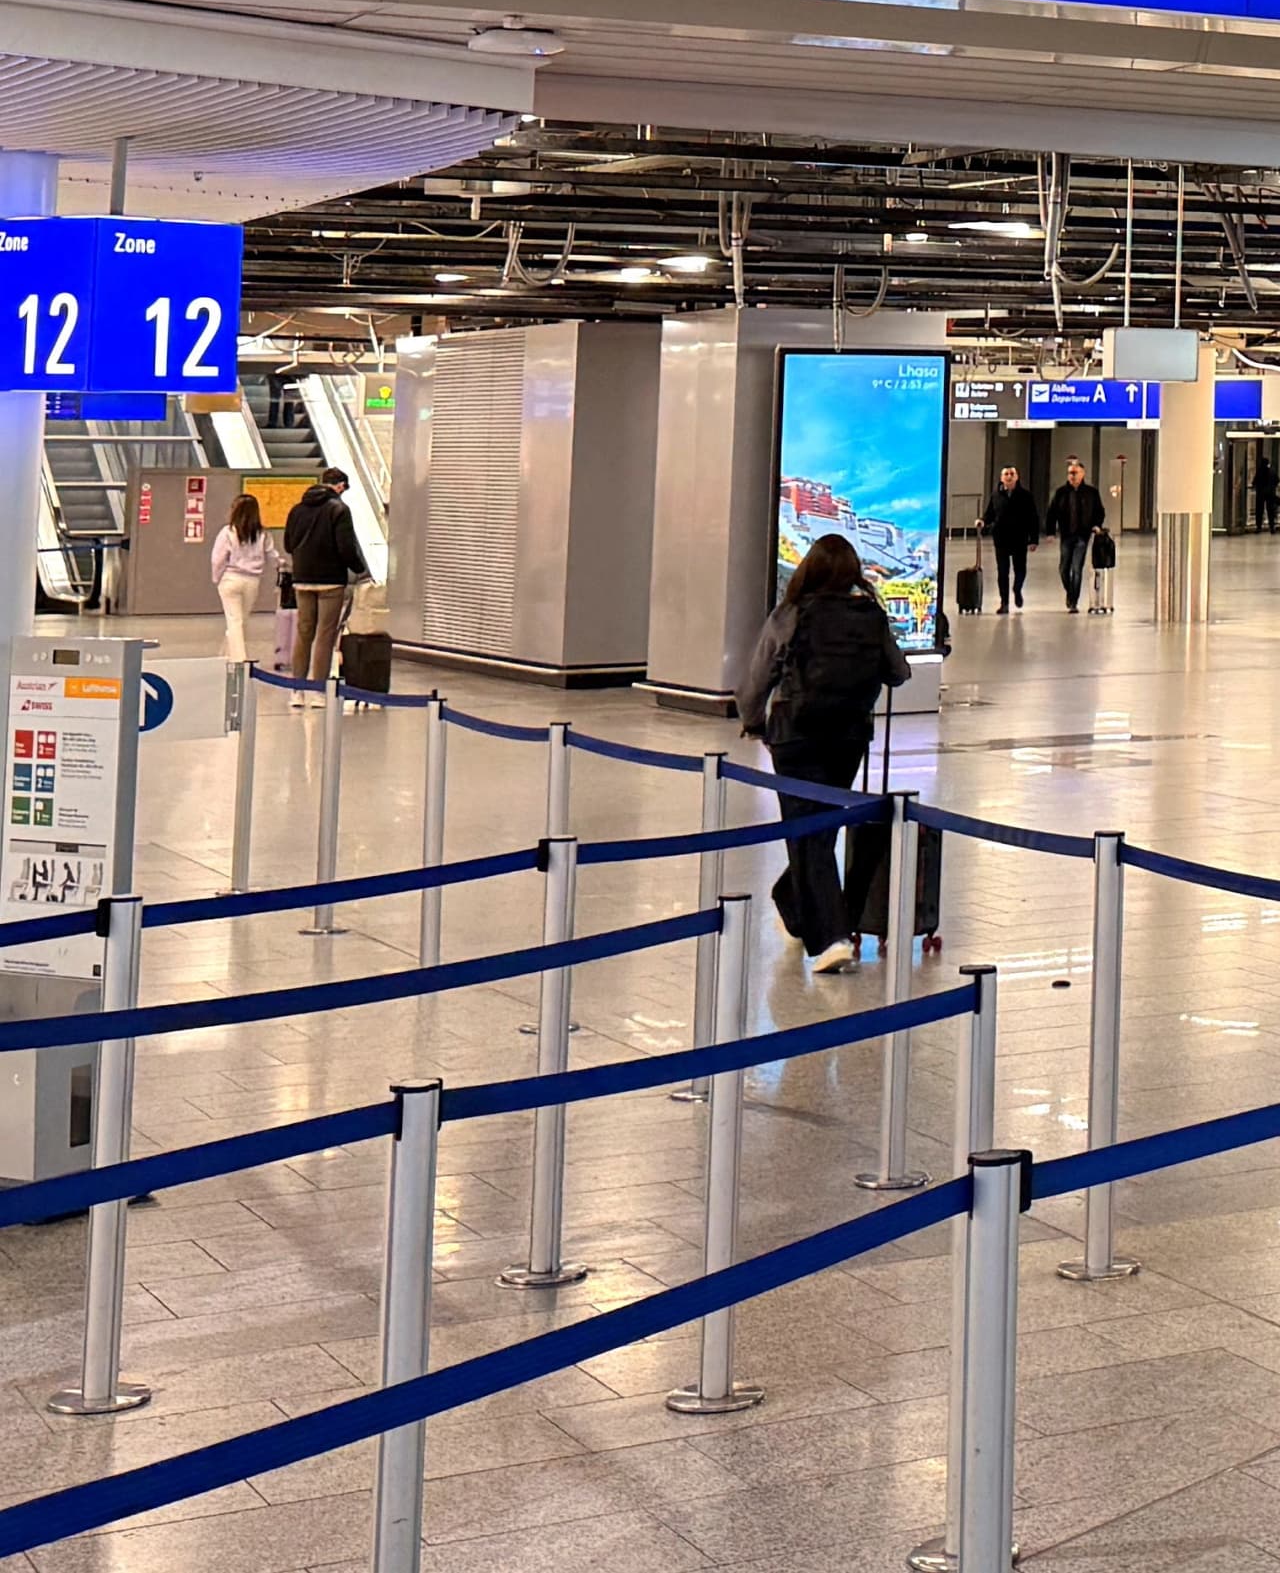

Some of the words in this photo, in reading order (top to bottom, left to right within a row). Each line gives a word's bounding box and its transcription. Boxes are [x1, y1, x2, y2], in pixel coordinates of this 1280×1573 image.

[0, 232, 28, 251] Zone
[114, 233, 156, 253] Zone
[18, 293, 78, 374] 12
[145, 297, 222, 377] 12
[898, 365, 938, 377] Lhasa
[1093, 384, 1106, 403] A
